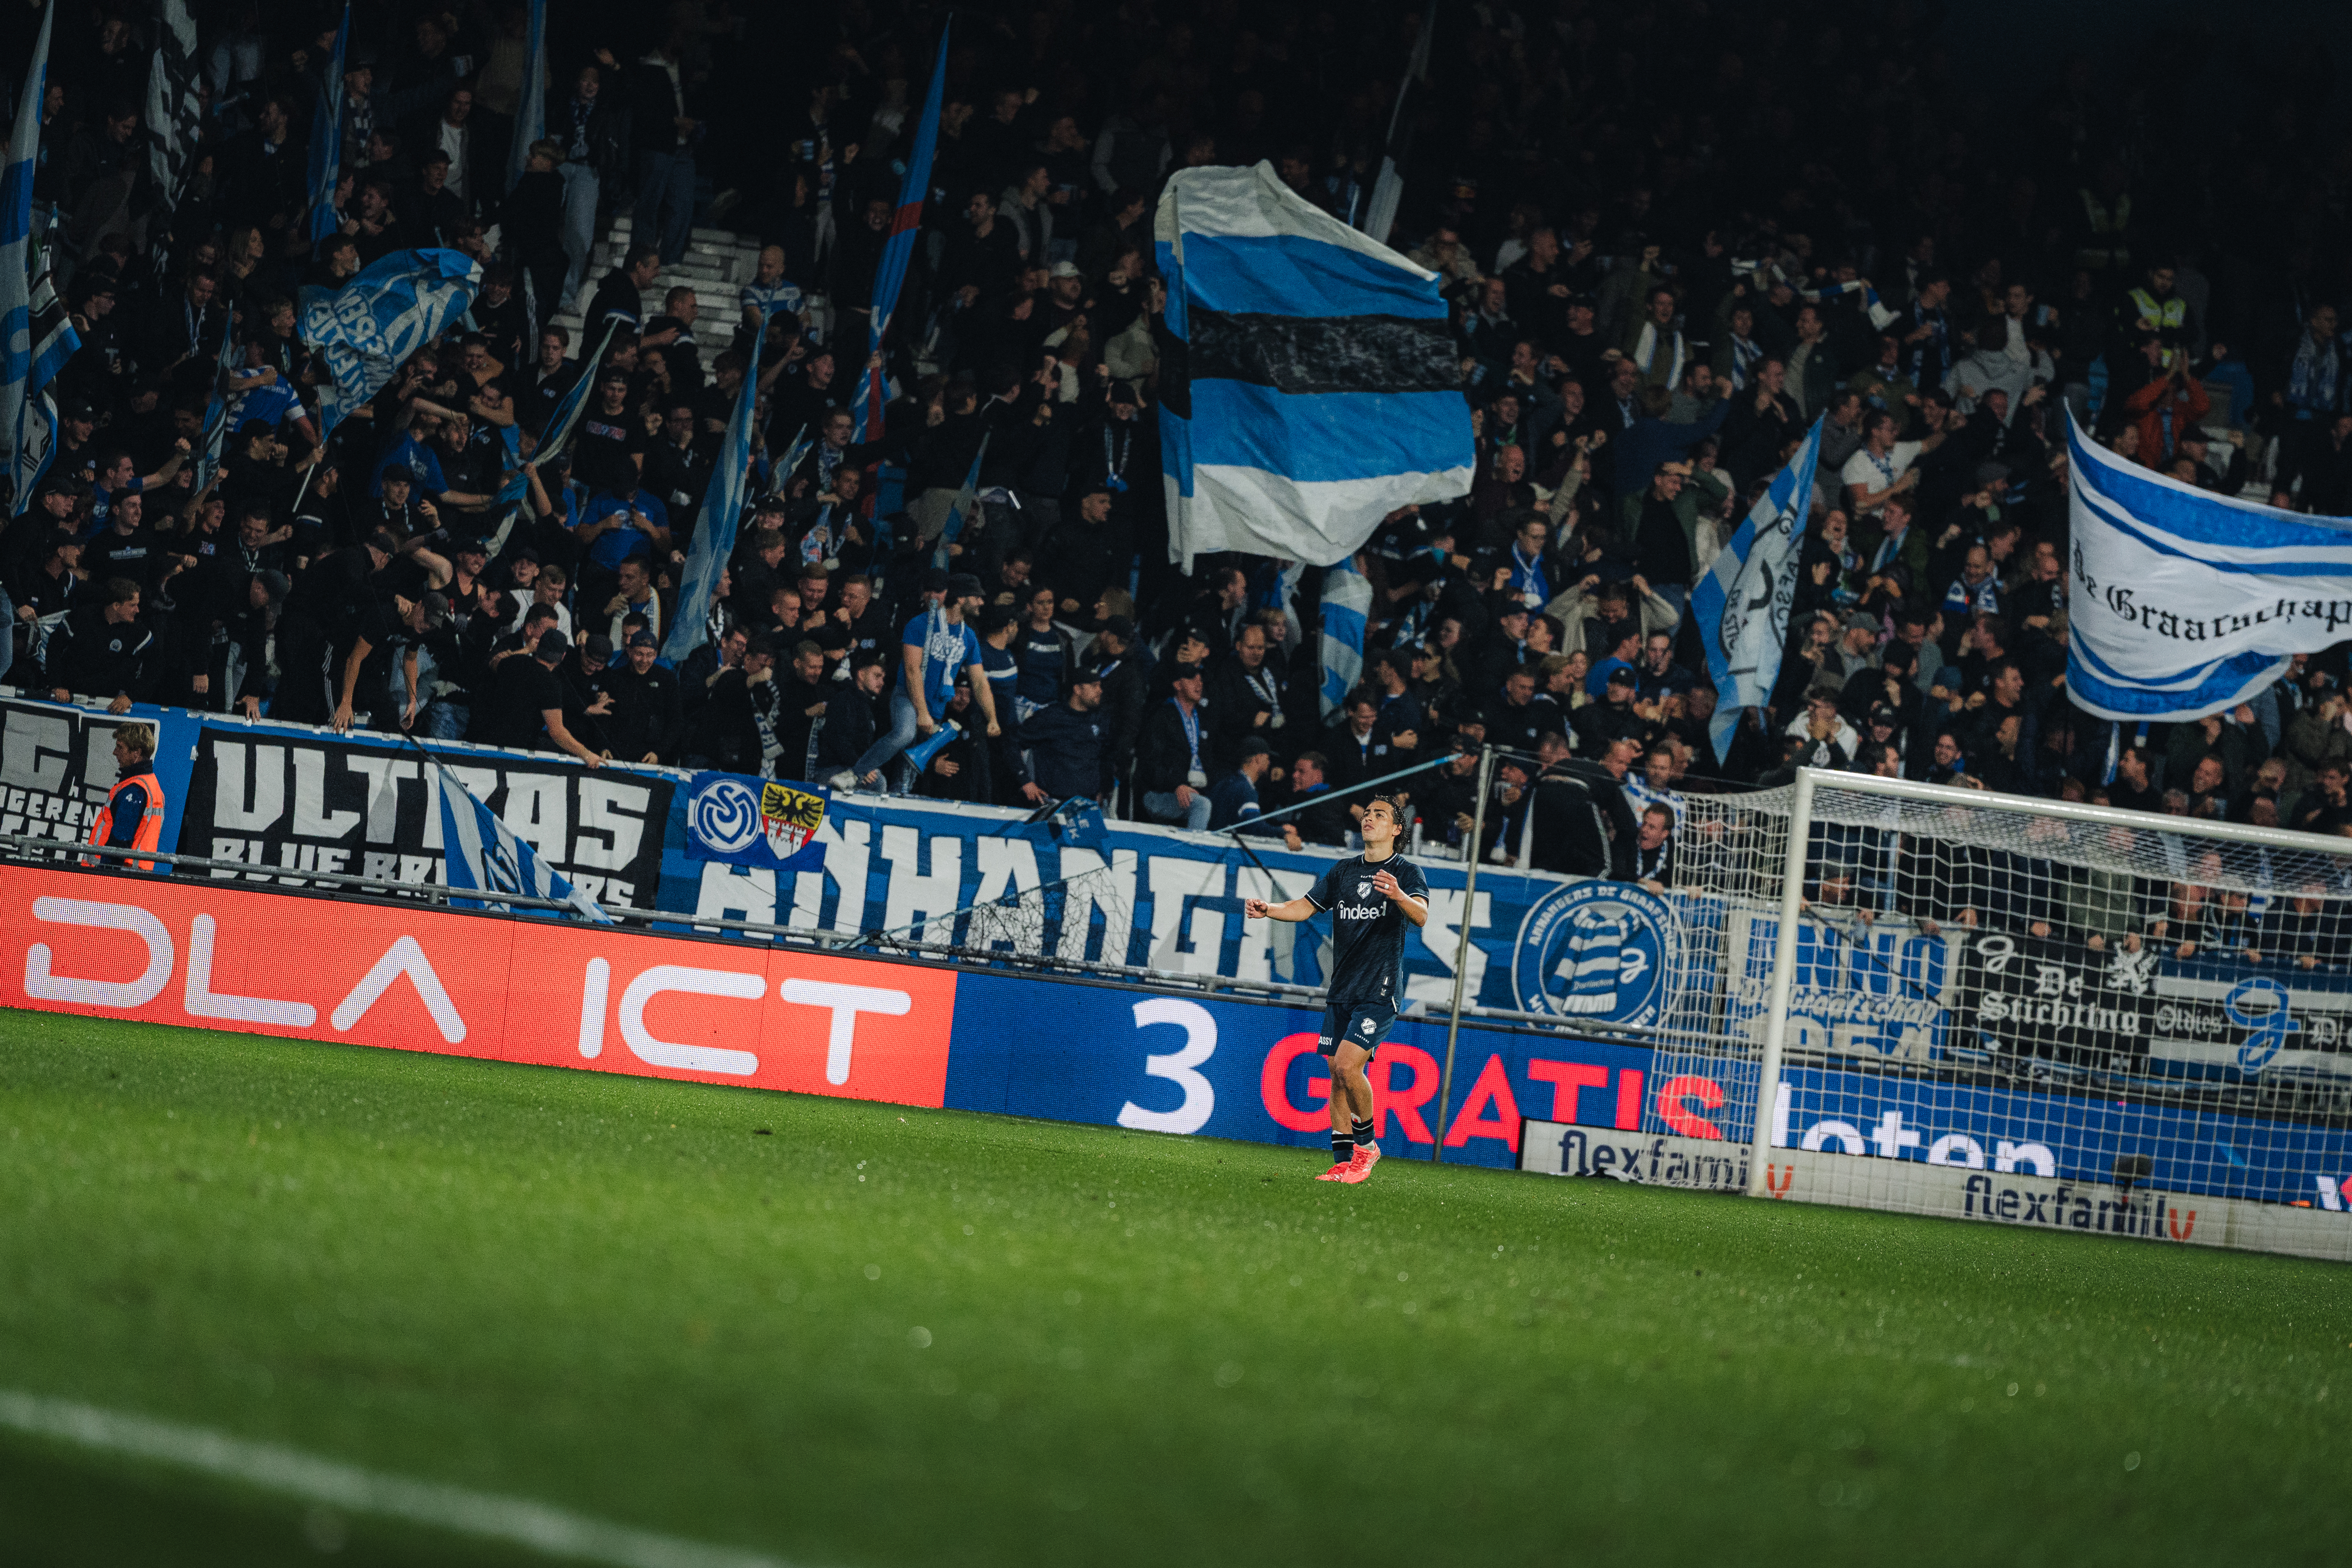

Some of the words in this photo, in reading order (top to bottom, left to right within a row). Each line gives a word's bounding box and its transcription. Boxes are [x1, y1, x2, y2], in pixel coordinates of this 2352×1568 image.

[210, 837, 351, 889] BLUE
[694, 816, 1493, 1012] ANHANGES
[1337, 900, 1386, 920] indeed
[24, 895, 467, 1044] DLA
[578, 956, 912, 1086] ICT
[2034, 963, 2084, 997] De
[1977, 992, 2139, 1037] Stichting
[1117, 998, 1218, 1135] 3
[1261, 1032, 1723, 1153] GRATIS
